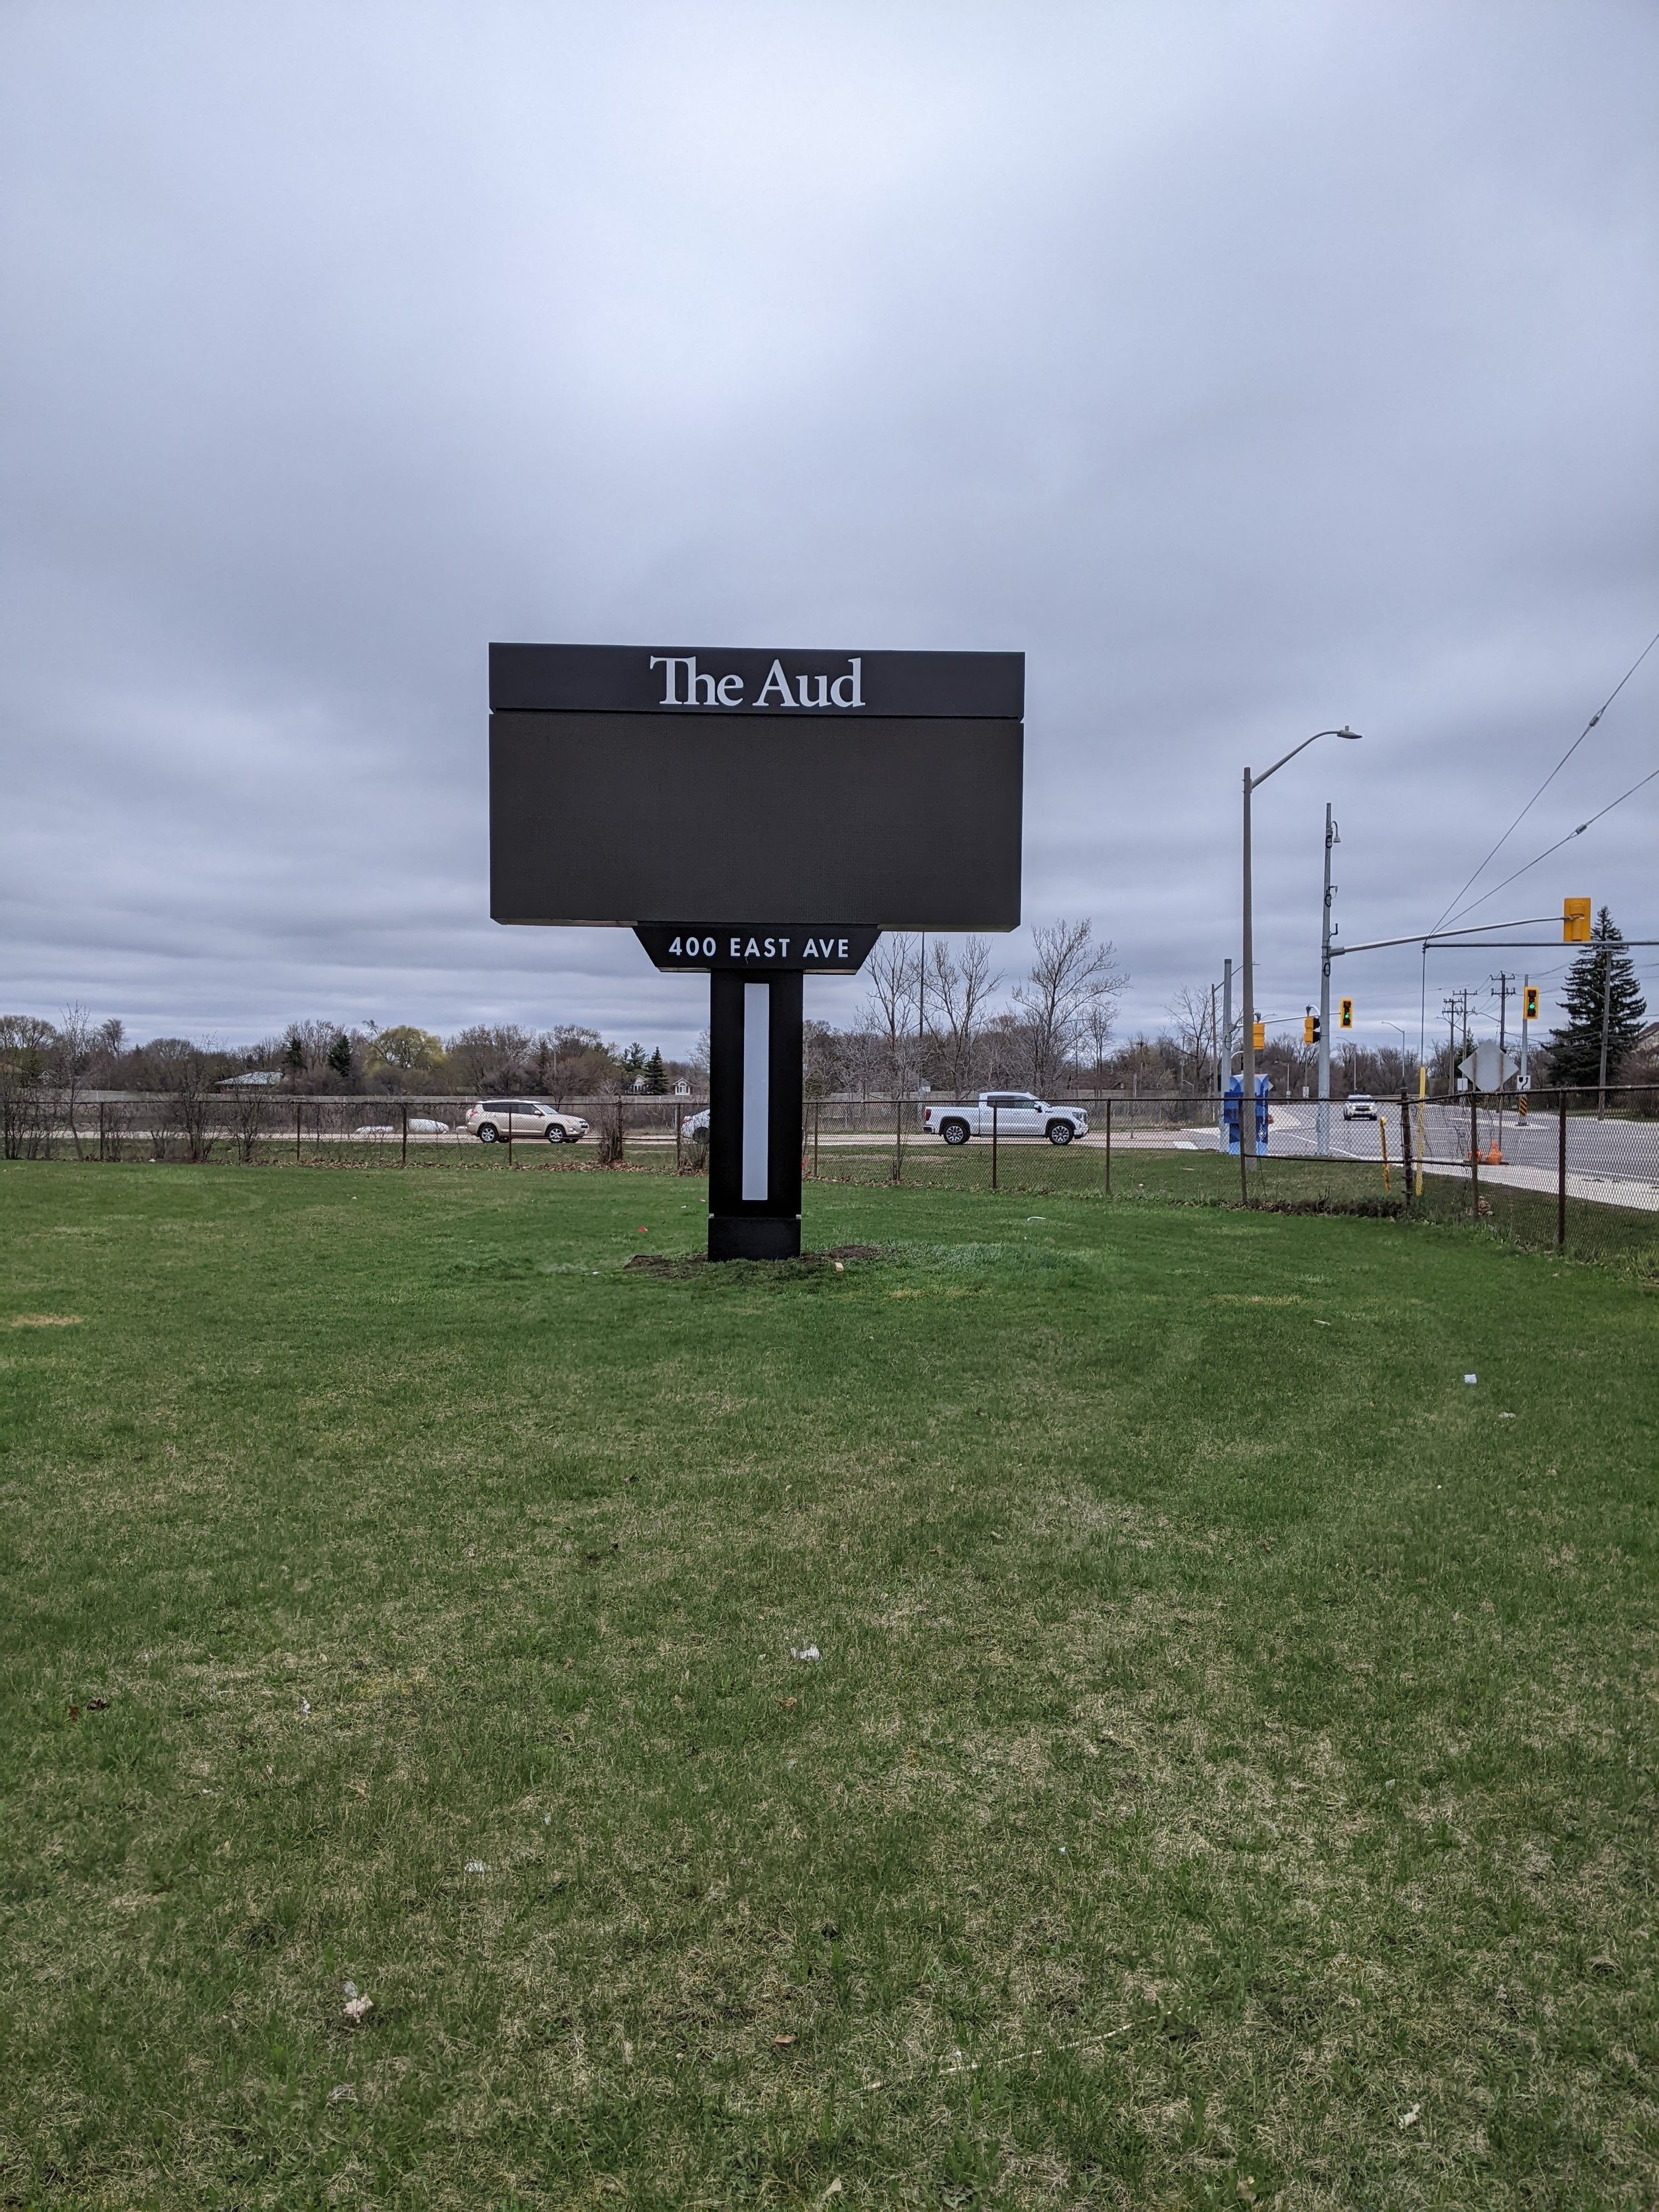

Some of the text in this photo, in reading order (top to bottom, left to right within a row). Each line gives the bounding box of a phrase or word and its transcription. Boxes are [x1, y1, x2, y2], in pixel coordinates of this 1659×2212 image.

[650, 655, 866, 707] The Aud
[668, 936, 848, 958] 400 EAST AVE
